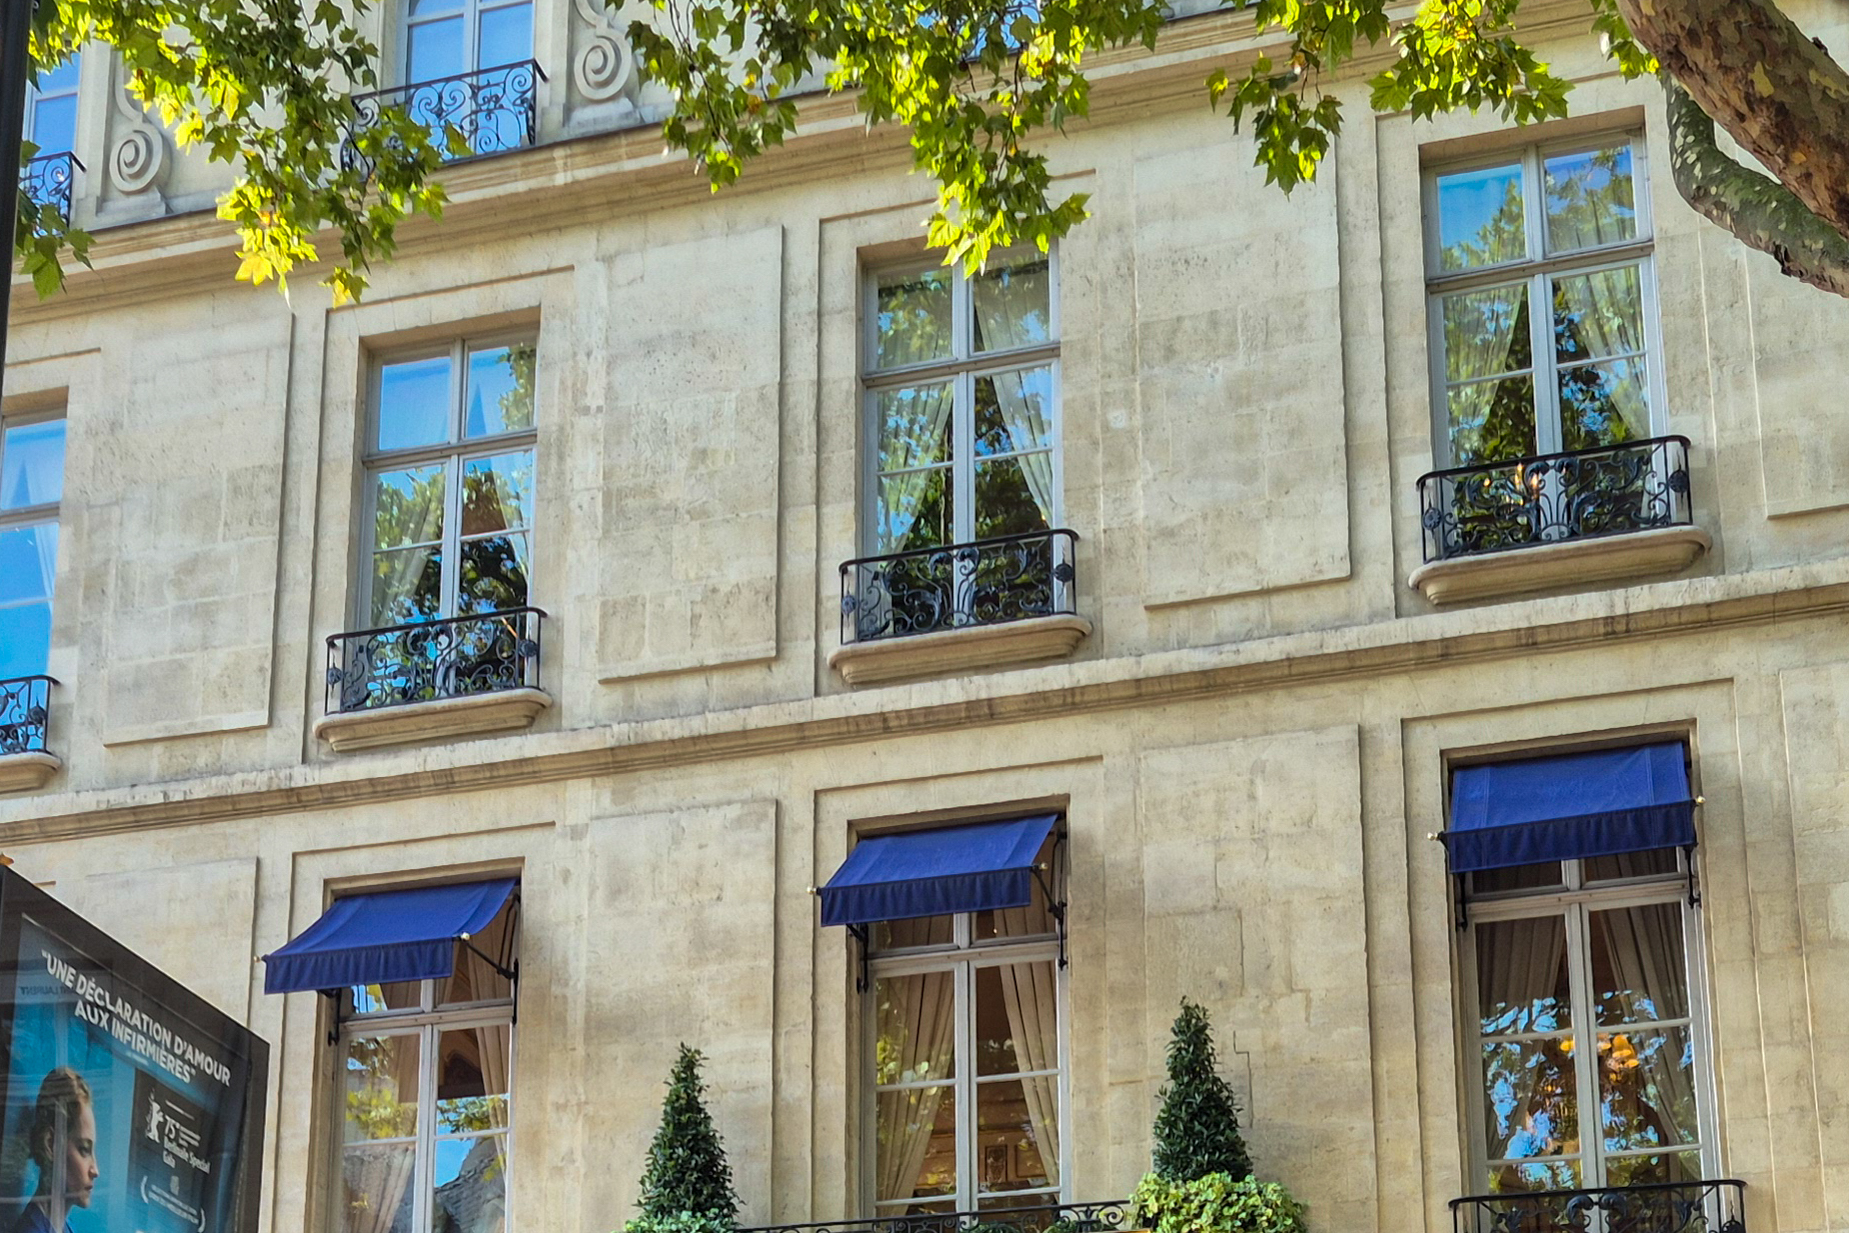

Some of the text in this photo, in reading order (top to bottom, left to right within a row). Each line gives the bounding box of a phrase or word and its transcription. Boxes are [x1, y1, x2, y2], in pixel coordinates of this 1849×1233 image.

[41, 949, 231, 1087] "UNE DÉCLARATION D'AMOUR
[74, 1000, 109, 1031] AUX
